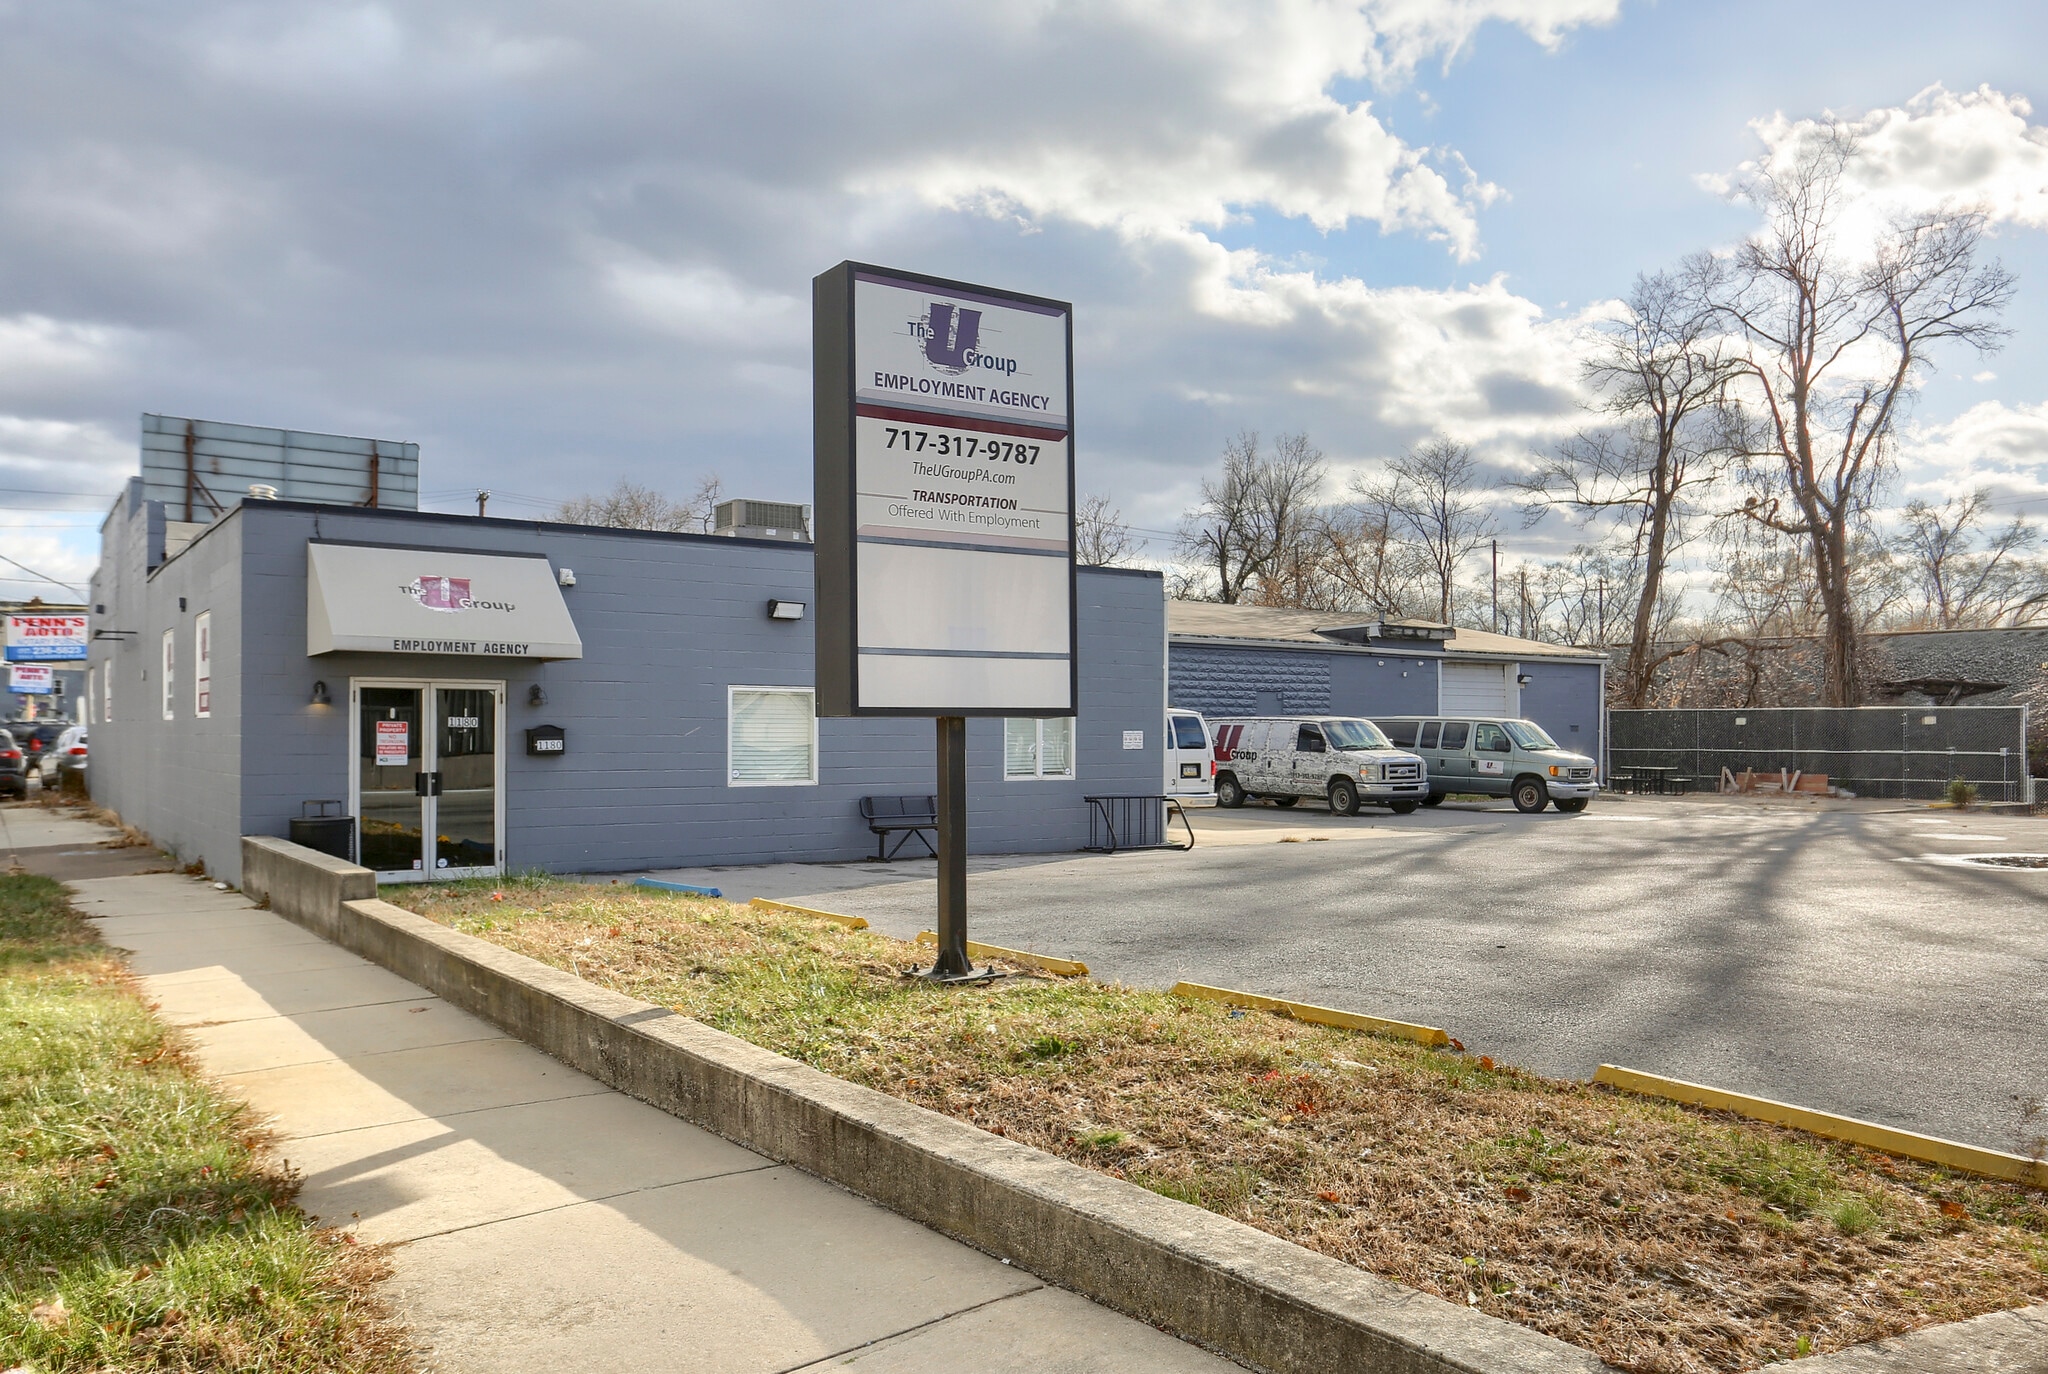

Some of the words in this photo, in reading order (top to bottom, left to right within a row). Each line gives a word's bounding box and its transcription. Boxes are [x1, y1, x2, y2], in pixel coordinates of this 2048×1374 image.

[907, 321, 935, 340] The
[925, 302, 982, 369] U
[962, 348, 1017, 376] Group
[874, 372, 986, 401] EMPLOYMENT
[989, 389, 1050, 410] AGENCY
[885, 428, 1040, 465] 717-317-9787
[912, 461, 1016, 485] TheUGroupPA.com
[912, 490, 1018, 511] TRANSPORTATION
[888, 504, 934, 520] Offered
[938, 509, 965, 523] With
[969, 512, 1040, 529] Employment
[399, 585, 427, 596] The
[459, 598, 516, 612] Group
[24, 628, 74, 637] AUTO
[393, 639, 477, 653] EMPLOYMENT
[483, 643, 529, 655] AGENCY
[448, 717, 478, 727] 1180
[537, 740, 563, 750] 1180
[1230, 749, 1258, 763] Group
